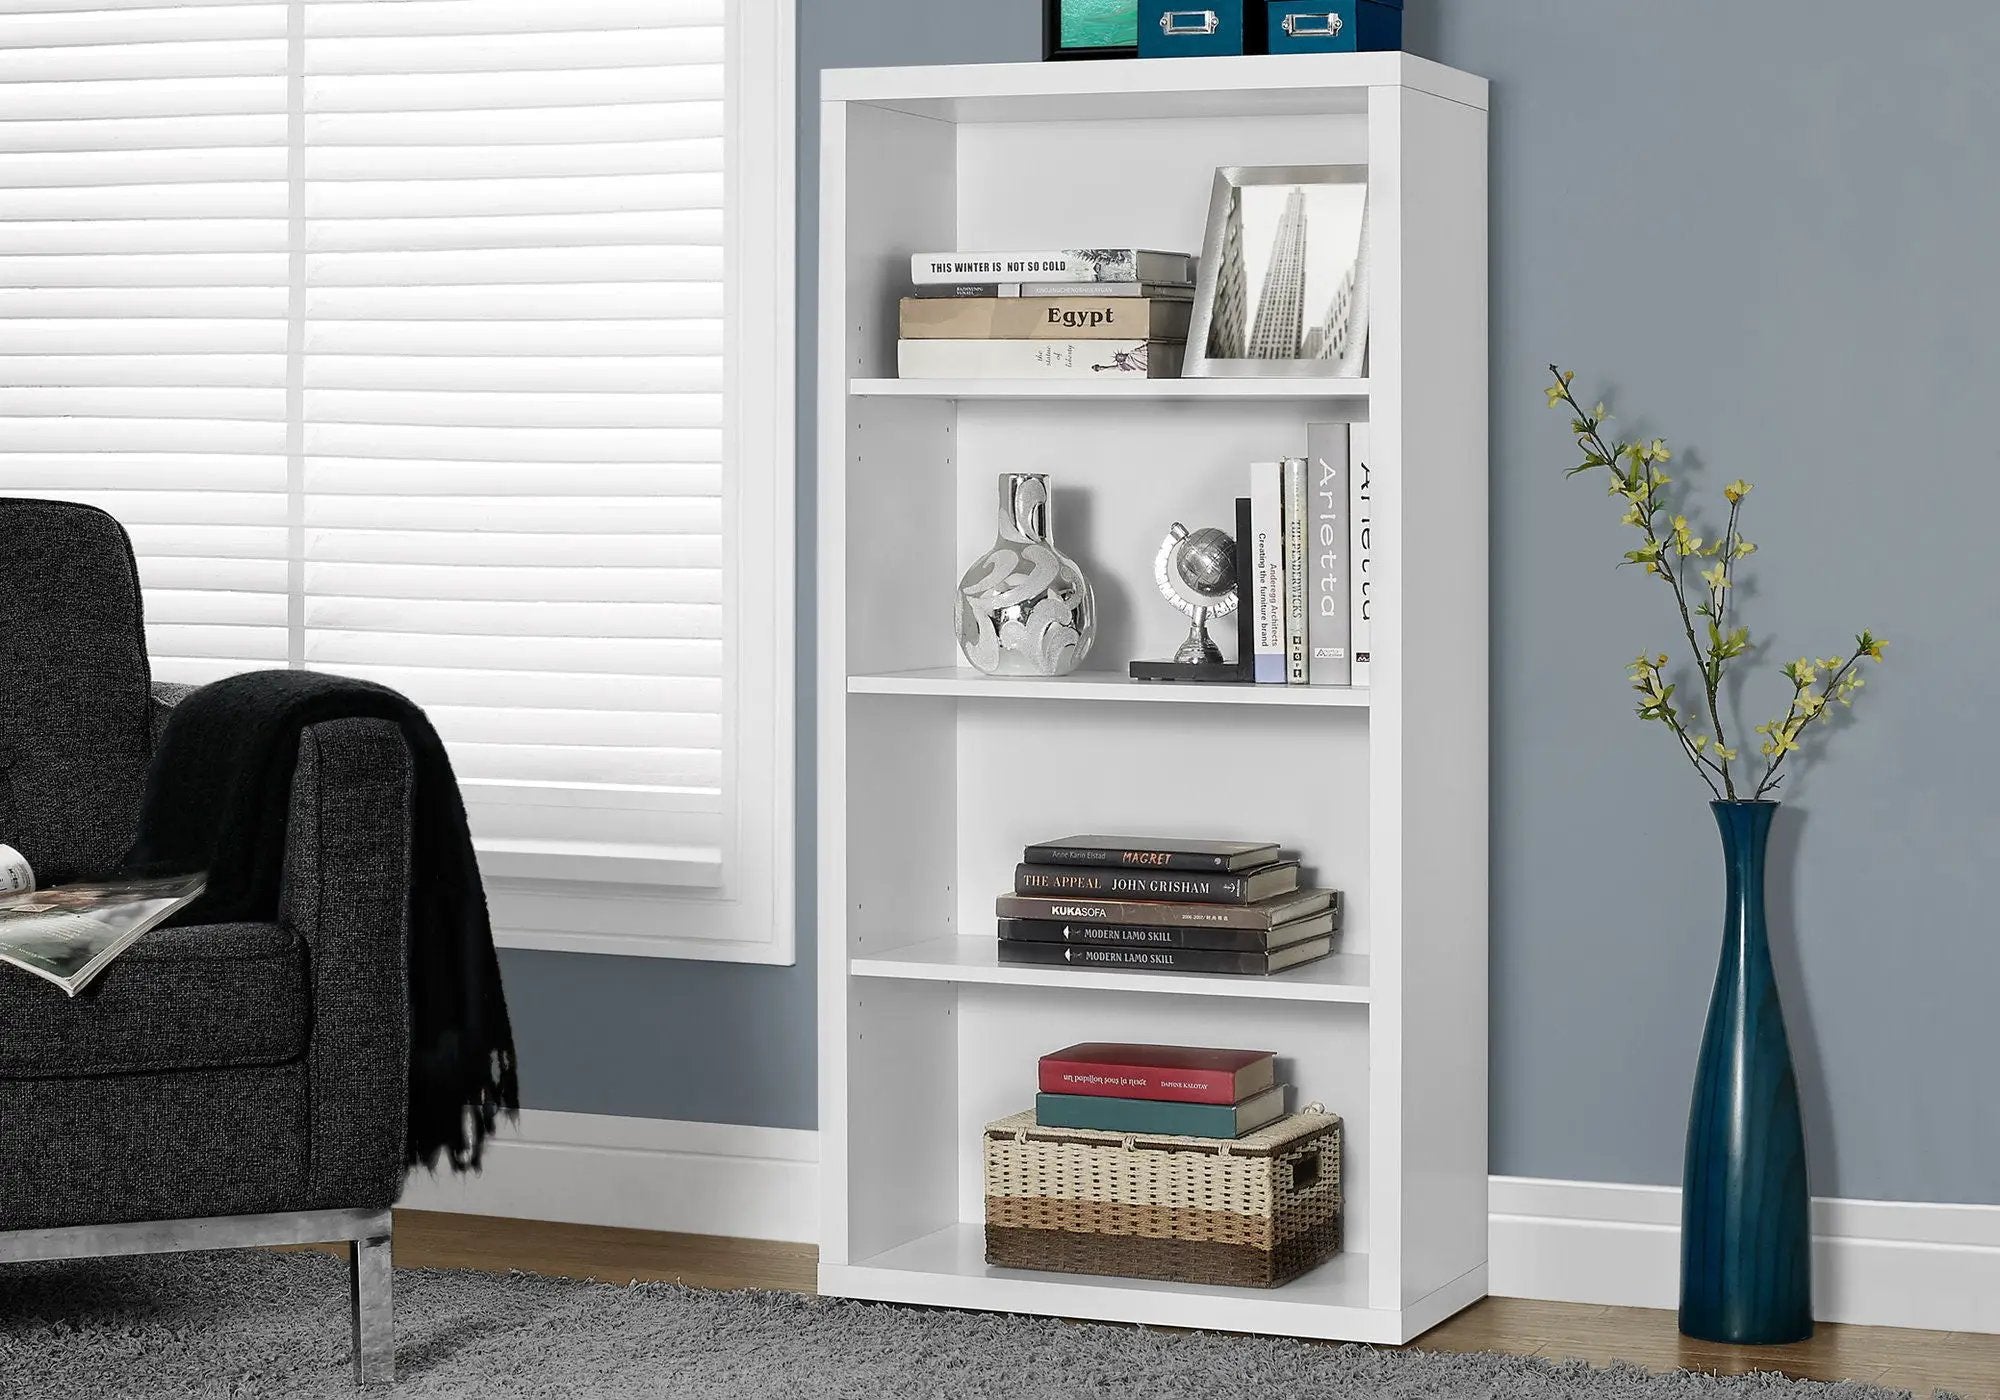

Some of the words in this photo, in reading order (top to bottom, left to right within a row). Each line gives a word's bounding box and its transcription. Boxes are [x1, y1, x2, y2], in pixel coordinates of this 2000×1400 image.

[930, 262, 952, 274] THIS
[954, 261, 990, 273] WINTER
[991, 261, 1002, 273] IS
[1007, 261, 1026, 272] NOT
[1027, 261, 1040, 272] SO
[1042, 260, 1066, 272] COLD
[1047, 307, 1114, 327] Egypt
[1319, 457, 1336, 617] Arletta
[1258, 533, 1267, 569] Creating
[1268, 563, 1277, 603] Anderegg
[1291, 543, 1302, 619] PENDERWICKS
[1260, 586, 1268, 621] furniture
[1261, 623, 1269, 647] brand
[1271, 605, 1279, 647] Architects
[1121, 851, 1172, 865] MAGRET
[1023, 874, 1049, 887] THE
[1053, 876, 1102, 889] APPEAL
[1111, 877, 1147, 891] JOHN
[1149, 879, 1210, 894] GRISHAM
[1051, 905, 1107, 918] KUKASOFA
[1084, 928, 1120, 940] MODERN
[1122, 929, 1146, 941] LAMO
[1148, 930, 1172, 942] SKILL
[1085, 951, 1122, 963] MODERN
[1124, 952, 1148, 964] LAMO
[1150, 953, 1174, 965] SKILL
